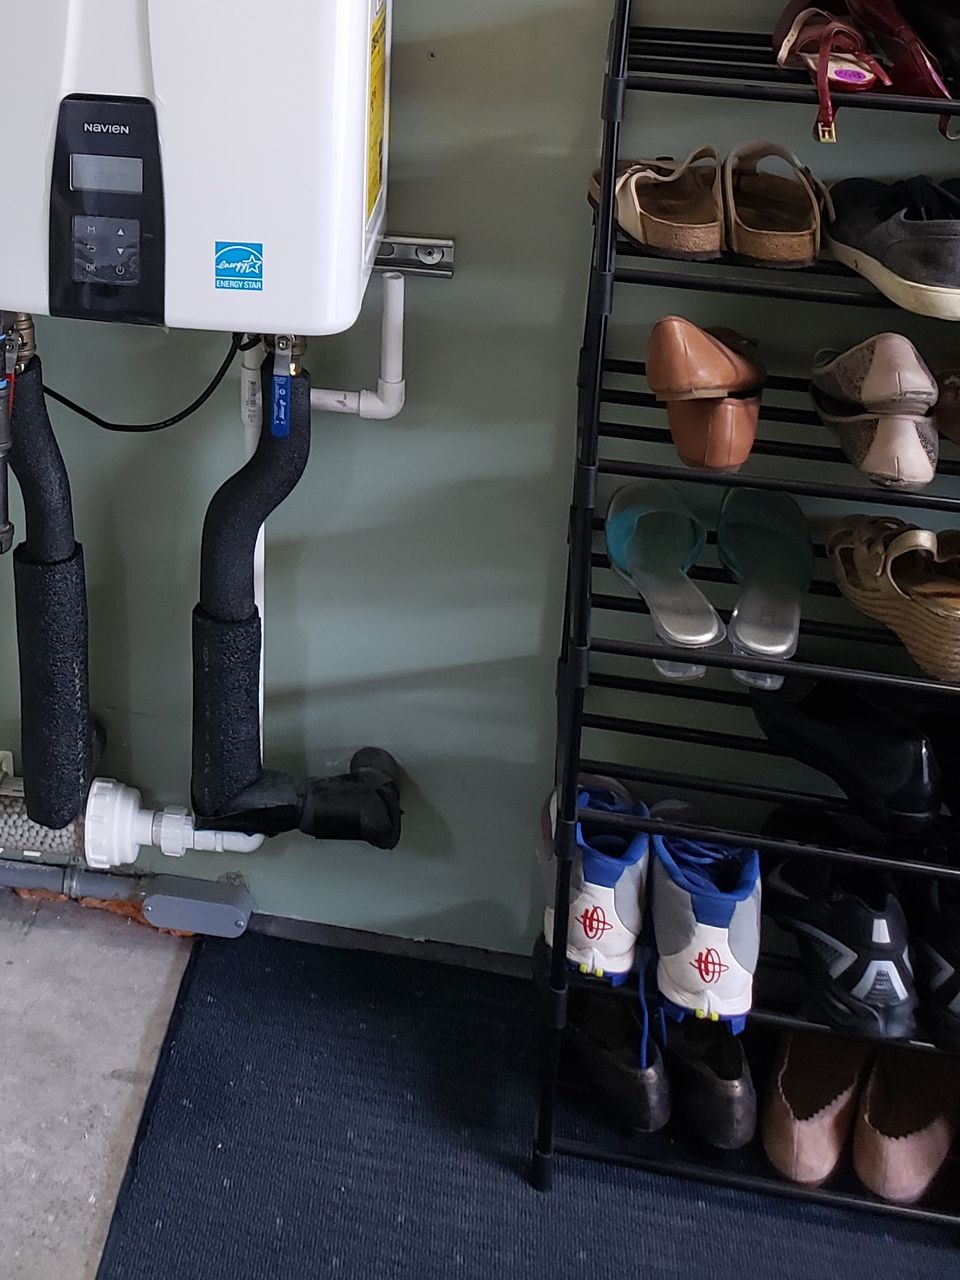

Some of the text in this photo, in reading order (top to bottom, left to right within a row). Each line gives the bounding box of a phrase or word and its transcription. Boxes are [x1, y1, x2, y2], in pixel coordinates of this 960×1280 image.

[87, 225, 96, 234] M
[85, 263, 96, 272] OK
[216, 279, 262, 289] ENERGY STAR
